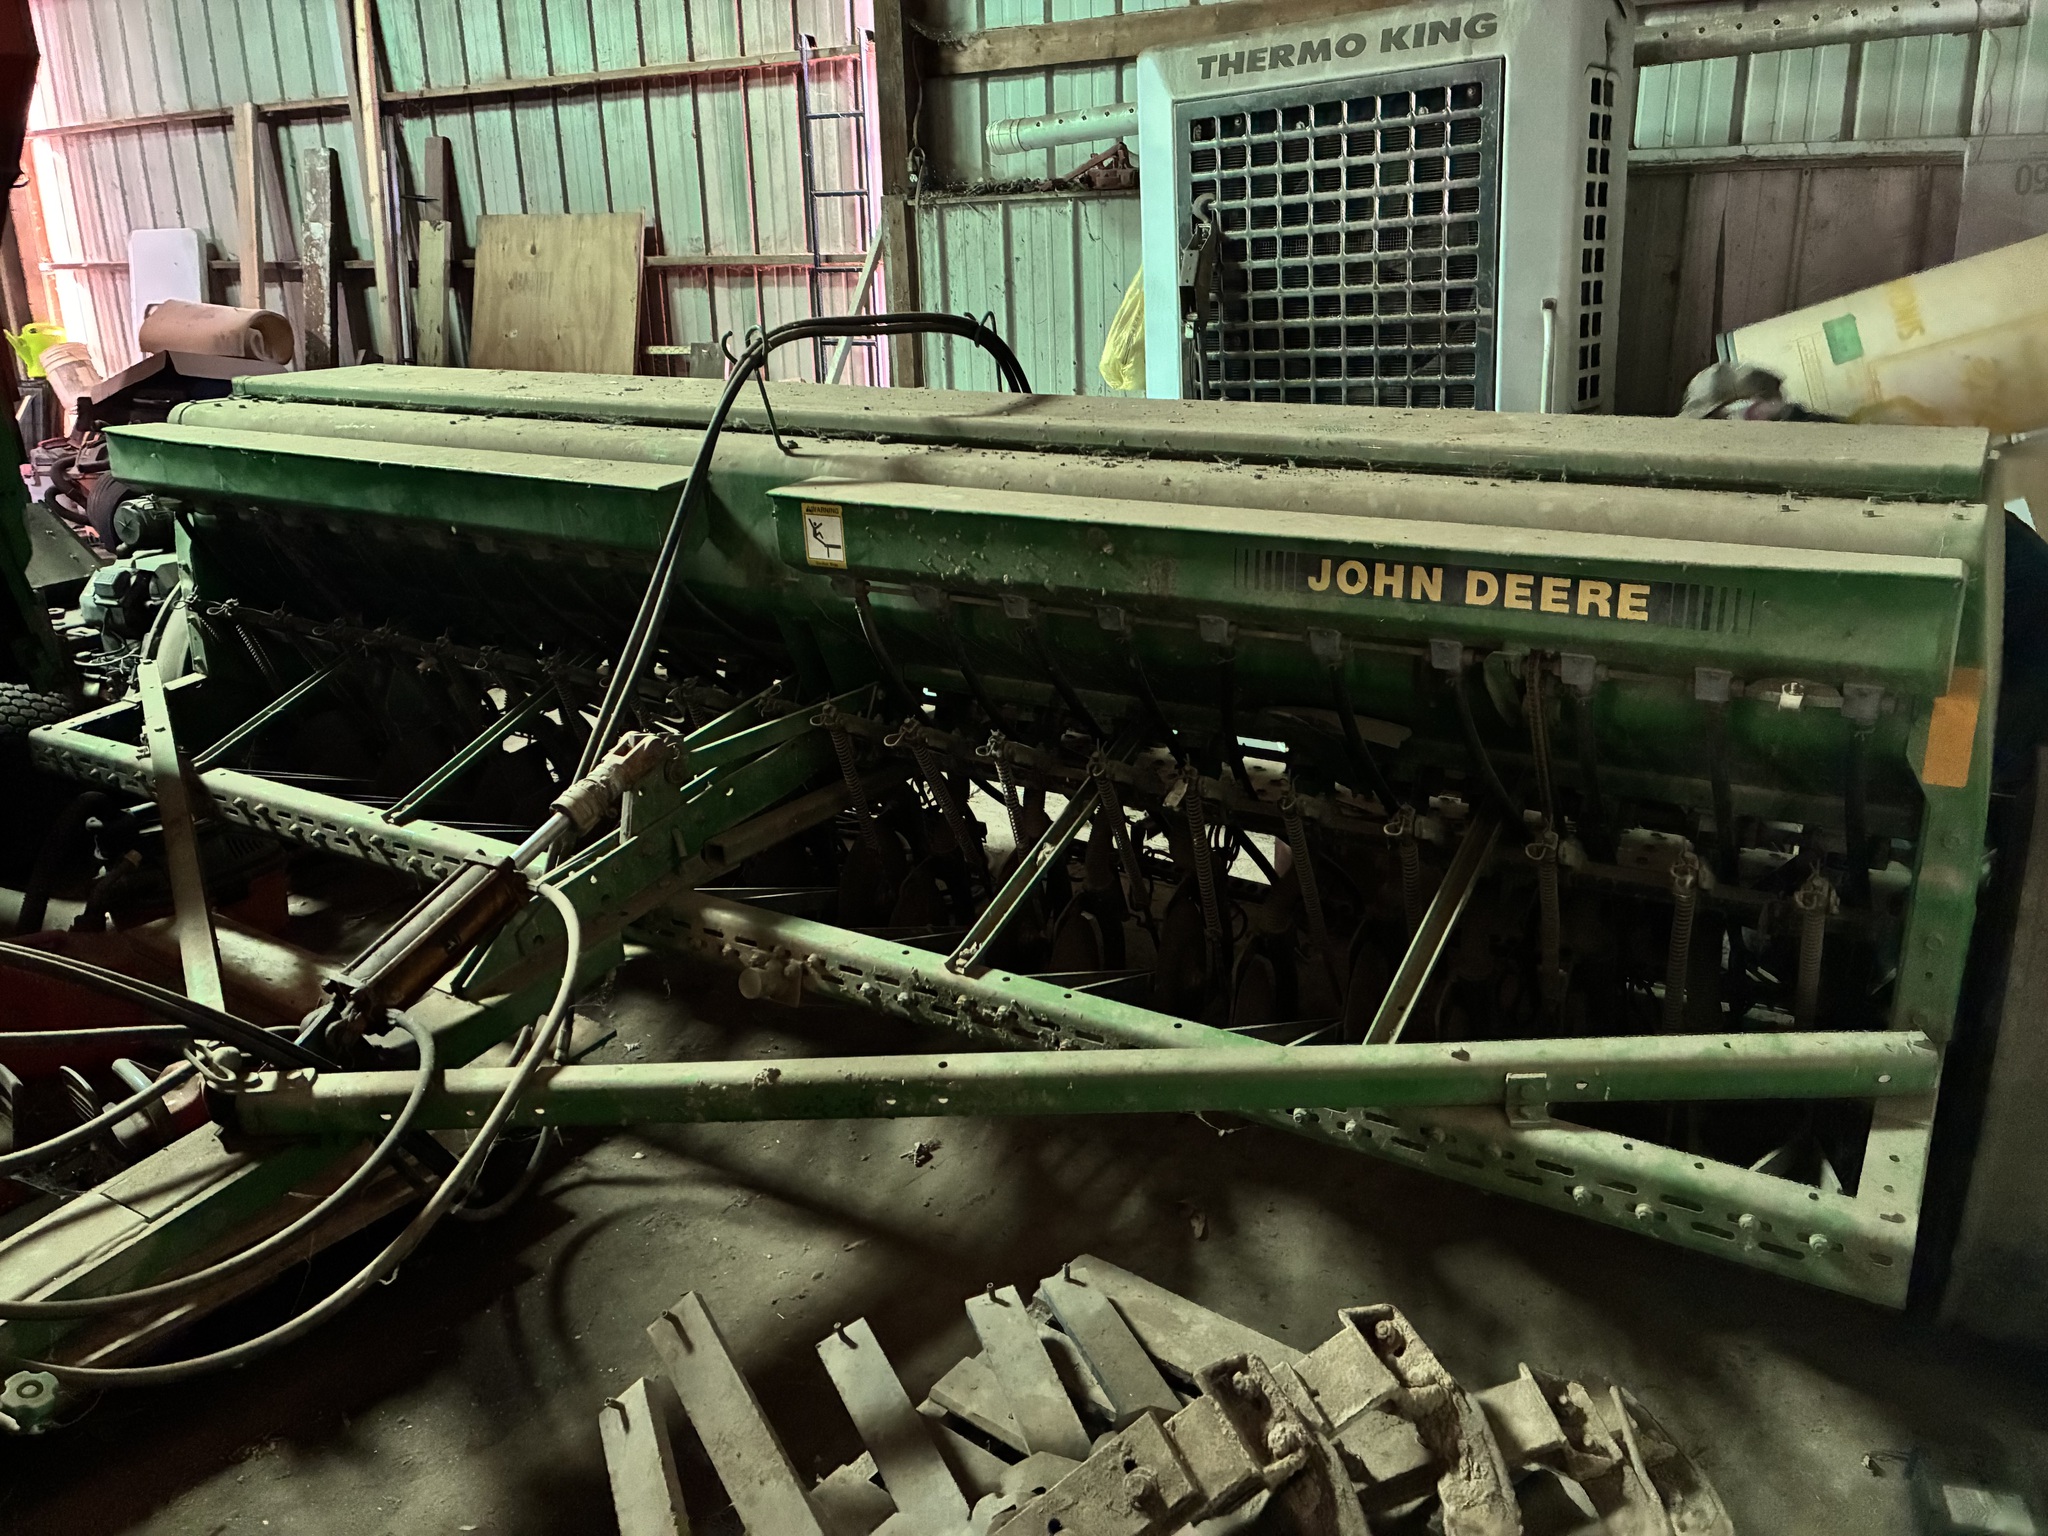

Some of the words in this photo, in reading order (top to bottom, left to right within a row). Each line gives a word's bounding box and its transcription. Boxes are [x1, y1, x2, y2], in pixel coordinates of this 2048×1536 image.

[1197, 33, 1367, 80] THERMO
[1380, 12, 1498, 53] KING
[811, 506, 839, 515] WARNING
[1307, 558, 1444, 602] JOHN
[1464, 570, 1652, 622] DEERE
